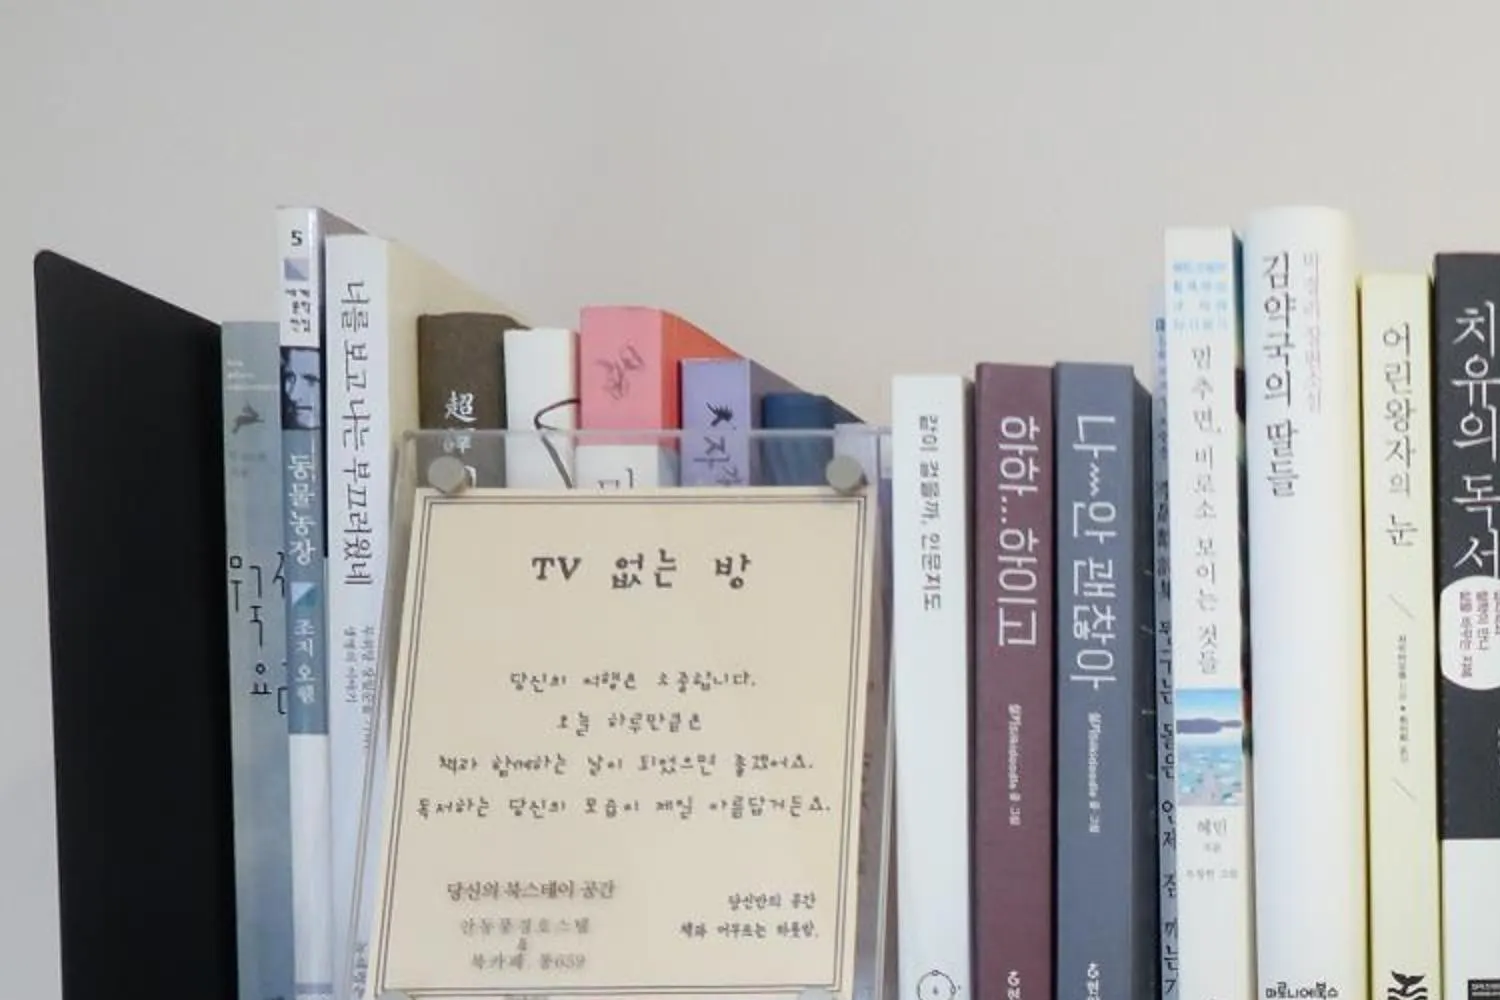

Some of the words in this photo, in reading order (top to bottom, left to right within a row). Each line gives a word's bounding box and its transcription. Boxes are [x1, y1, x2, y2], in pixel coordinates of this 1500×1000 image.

[290, 230, 303, 246] 5
[1262, 251, 1296, 407] 김약국의
[343, 340, 370, 391] 보고
[341, 398, 371, 451] 나는
[919, 414, 939, 453] 같이
[1194, 445, 1217, 520] 비로소
[1265, 418, 1299, 498] 딸들
[340, 457, 372, 585] 부끄러웠네
[1385, 514, 1418, 547] 눈
[531, 555, 582, 581] TV
[611, 548, 677, 590] 없는
[714, 553, 752, 590] 방
[920, 532, 942, 611] 인문지도
[1195, 537, 1218, 612] 보이는
[1070, 557, 1116, 691] 괜찮아
[1200, 623, 1217, 677] 것들
[510, 671, 567, 693] 당신의
[582, 670, 637, 692] 여행은
[557, 711, 590, 737] 오늘
[607, 711, 702, 734] 하루만큼은
[439, 755, 478, 777] 책과
[492, 753, 568, 778] 함께하는
[587, 755, 623, 777] 날이
[637, 753, 716, 777] 되었으면
[416, 796, 490, 820] 독서하는
[509, 797, 567, 819] 당신의
[584, 796, 640, 819] 모습이
[655, 796, 693, 820] 제일
[447, 880, 499, 902] 당신의
[504, 880, 575, 900] 북스테이
[579, 879, 616, 899] 공간
